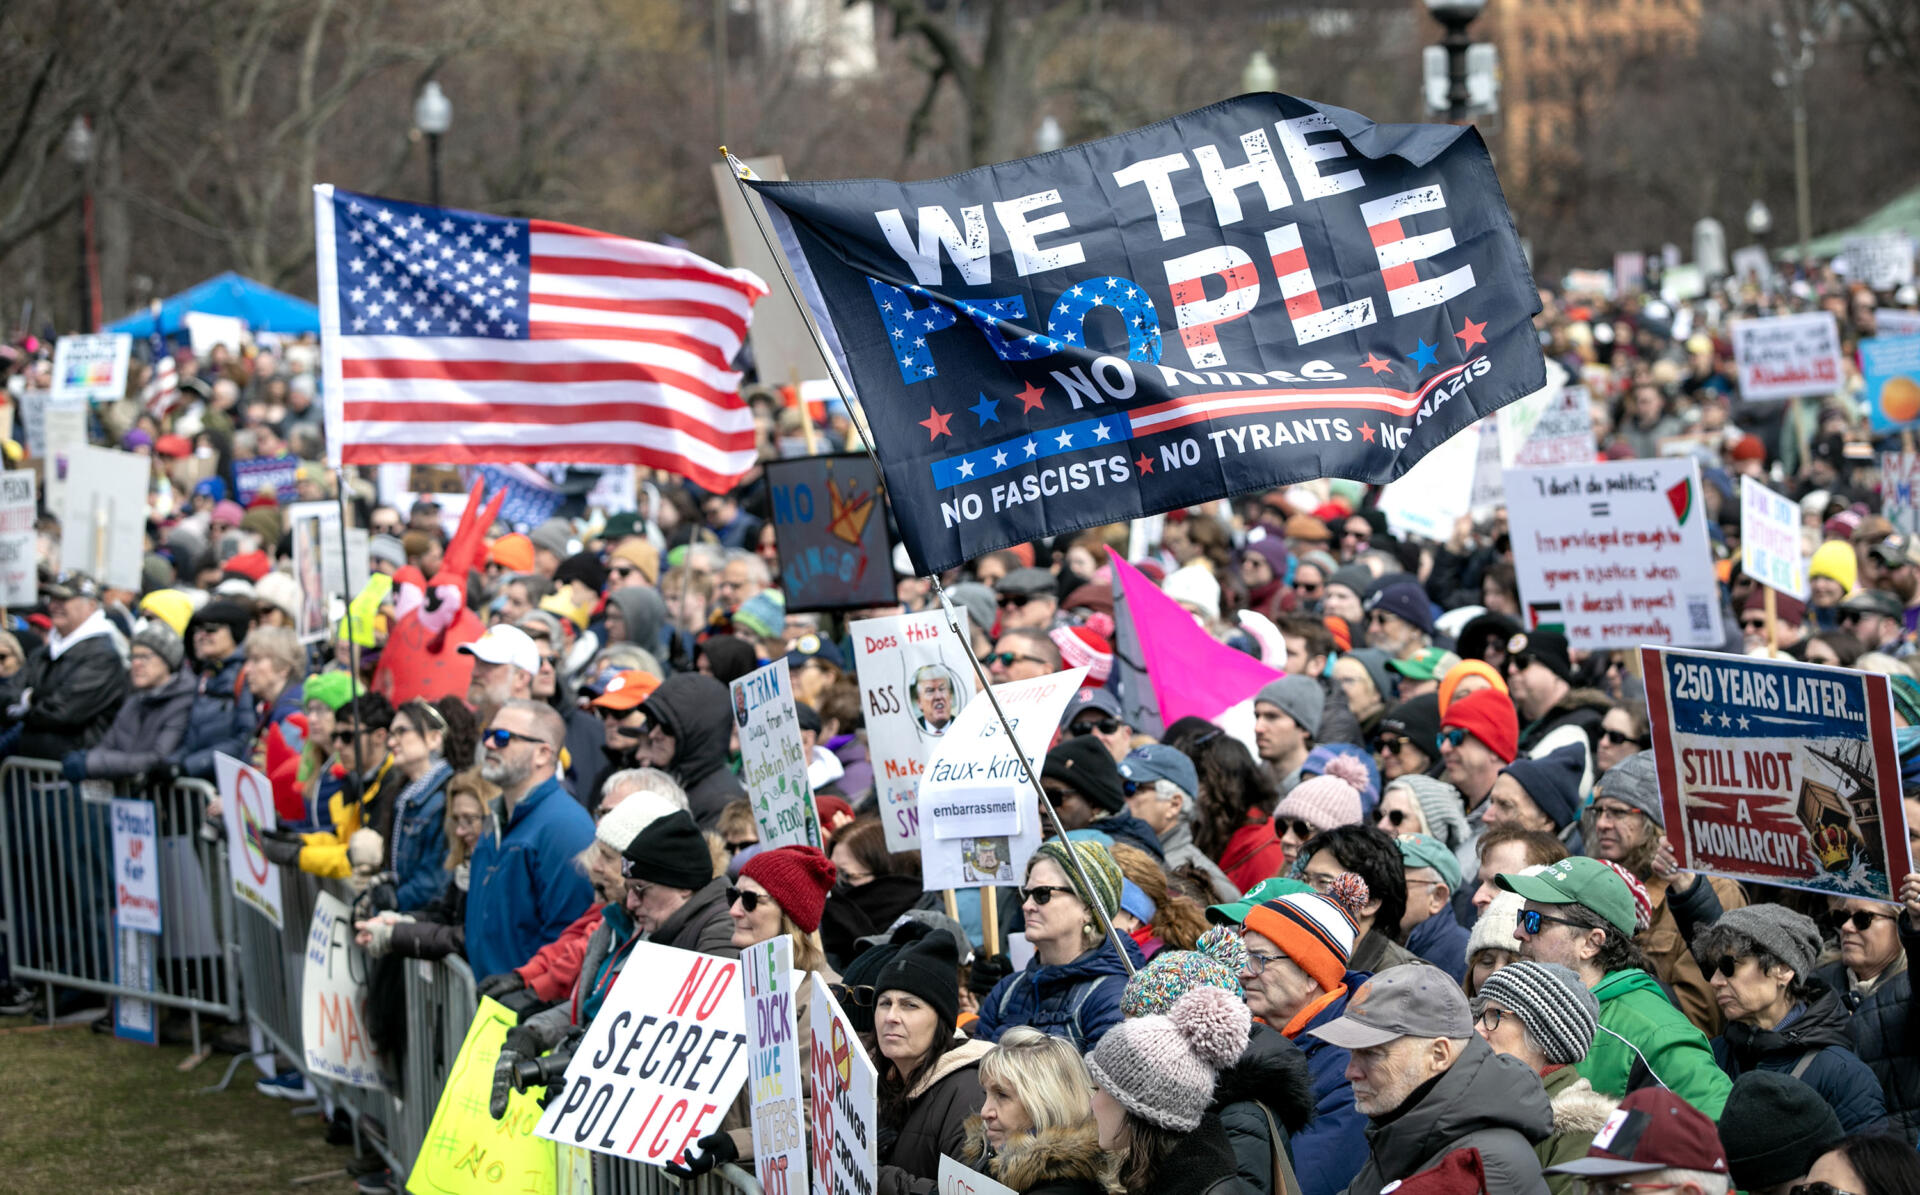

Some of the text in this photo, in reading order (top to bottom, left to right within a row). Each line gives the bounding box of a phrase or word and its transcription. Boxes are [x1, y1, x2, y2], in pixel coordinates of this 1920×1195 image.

[874, 112, 1366, 286] WE THE
[1050, 356, 1136, 410] NO
[940, 493, 983, 529] NO
[991, 455, 1130, 513] FASCISTS
[1159, 438, 1201, 472] NO
[1208, 418, 1353, 458] TYRANTS
[1380, 421, 1412, 451] NO
[1415, 355, 1492, 427] NAZIS
[773, 483, 814, 525] NO
[1559, 528, 1620, 553] privileged
[1622, 528, 1664, 552] enough
[1584, 564, 1637, 584] injustice
[1643, 565, 1680, 580] when
[1631, 588, 1675, 610] impact
[865, 623, 939, 654] Does this
[1571, 615, 1673, 645] me personally
[748, 666, 780, 710] IRAN
[869, 685, 900, 717] ASS
[1674, 662, 1865, 722] 250 YEARS LATER...
[783, 701, 796, 722] the
[979, 718, 998, 738] is
[746, 737, 803, 794] Epstein files
[885, 758, 924, 780] Make
[1682, 747, 1793, 792] STILL NOT
[933, 801, 1017, 818] embarrassment
[1736, 798, 1752, 824] A
[1693, 819, 1808, 870] MONARCHY.
[668, 956, 737, 1022] NO
[757, 991, 792, 1049] DICK
[592, 1011, 748, 1095] SECRET
[812, 1028, 868, 1150] NO KINGS
[550, 1075, 719, 1167] POLICE
[756, 1097, 800, 1157] TATERS
[812, 1076, 872, 1195] NO CROWNS
[761, 1153, 789, 1195] NOT
[812, 1124, 835, 1195] NO
